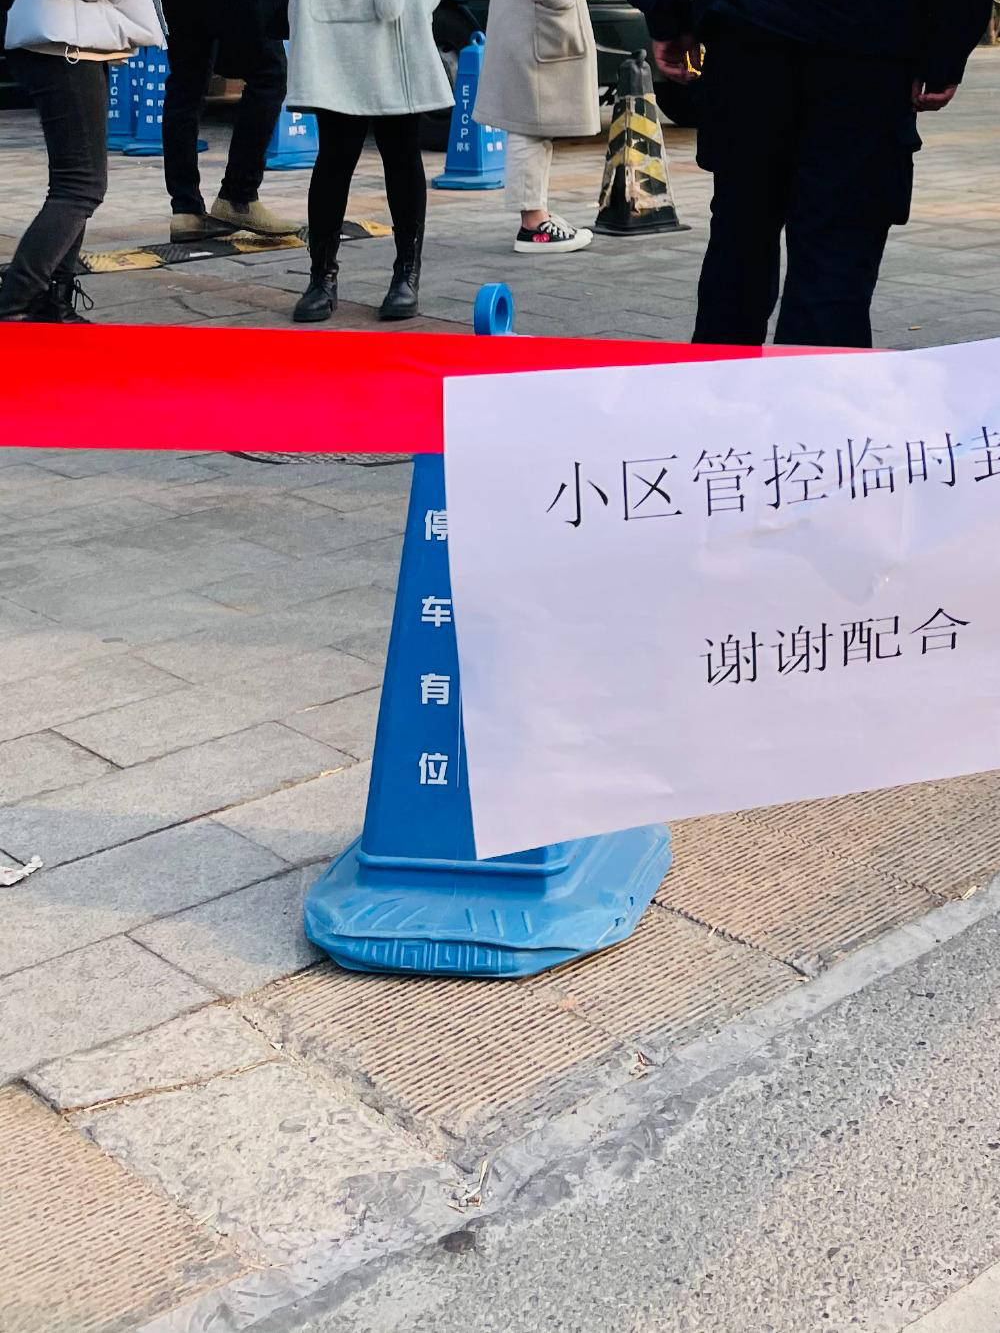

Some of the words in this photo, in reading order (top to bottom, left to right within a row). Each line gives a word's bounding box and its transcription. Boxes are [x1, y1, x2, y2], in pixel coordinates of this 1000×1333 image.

[461, 85, 470, 139] ETCP
[700, 607, 971, 688] 谢谢配合
